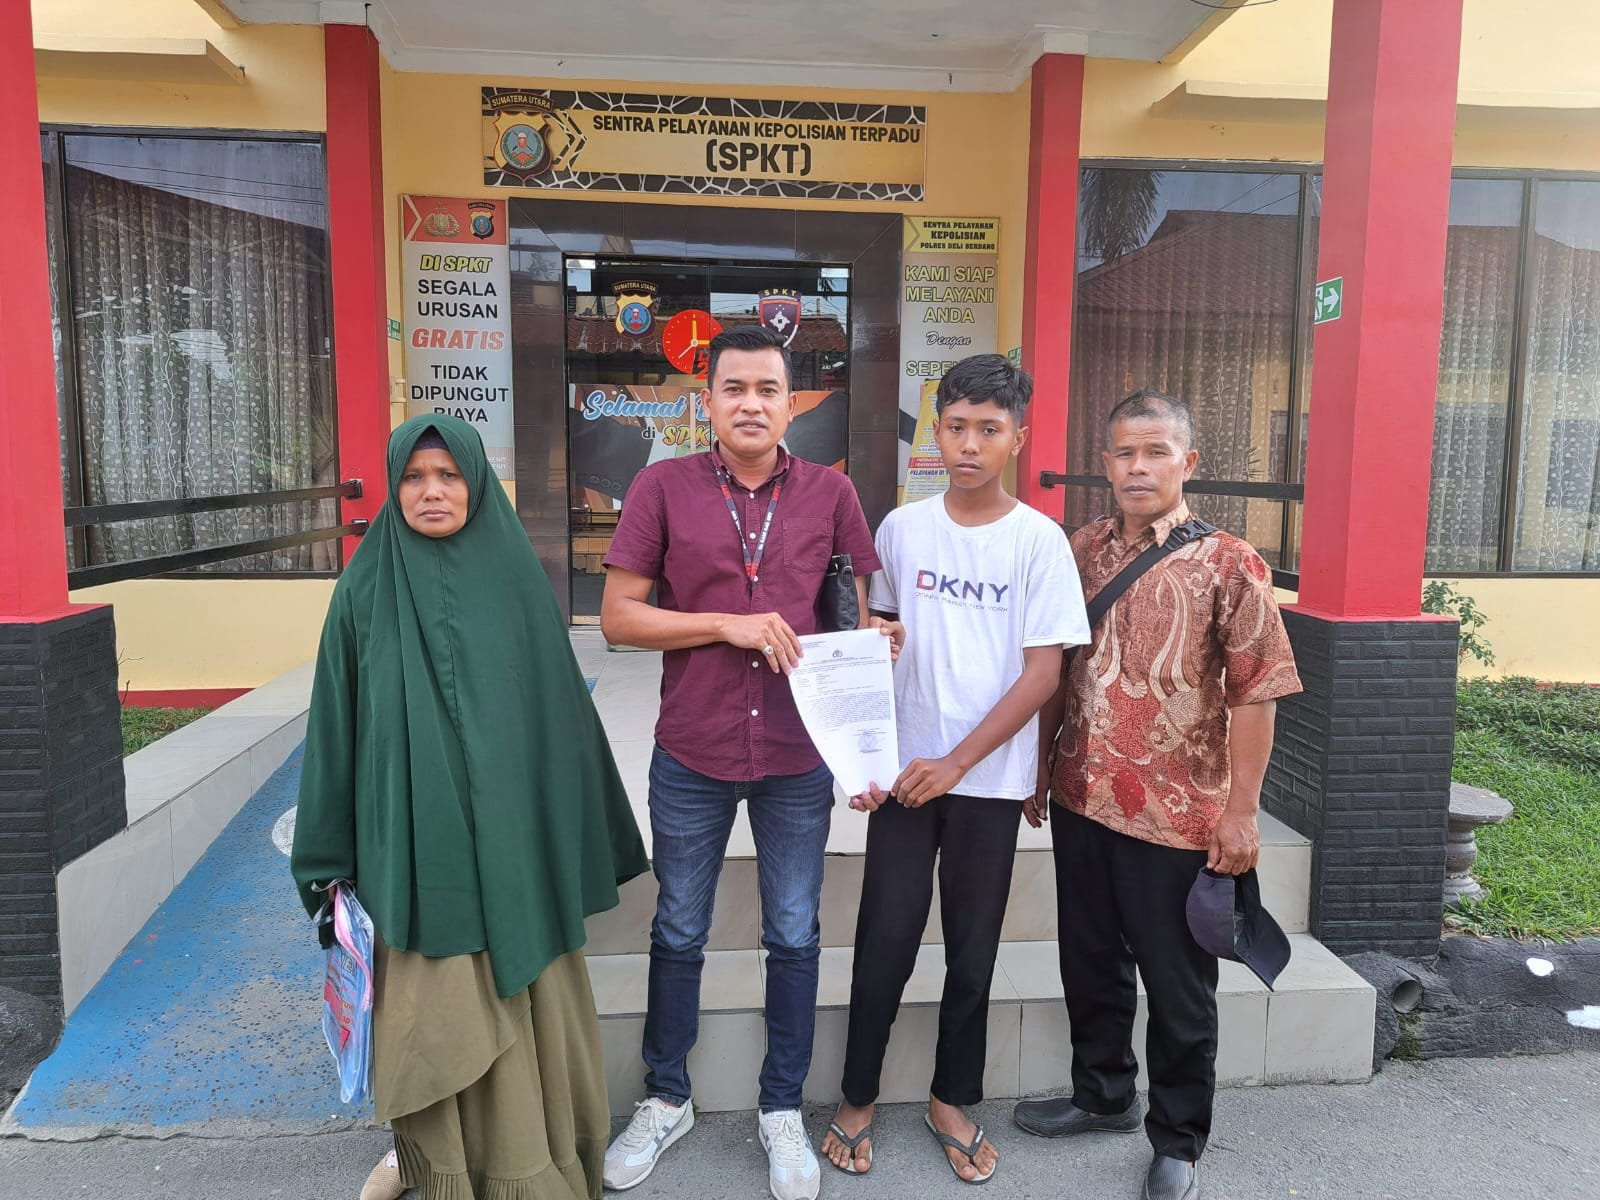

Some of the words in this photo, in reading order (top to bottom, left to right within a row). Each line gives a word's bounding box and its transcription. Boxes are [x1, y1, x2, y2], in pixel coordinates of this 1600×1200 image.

[492, 95, 528, 107] SUMATERA
[529, 96, 551, 109] UTARA
[593, 115, 655, 133] SENTRA
[658, 118, 751, 137] PELAYANAN
[754, 121, 846, 141] KEPOLISIAN
[850, 125, 921, 143] TERPADU
[705, 138, 812, 177] (SPKT)
[923, 221, 951, 229] SENTRA
[931, 231, 986, 240] KEPOLISIAN
[420, 255, 441, 271] DI
[443, 256, 493, 274] SPKT
[905, 265, 950, 281] KAMI
[954, 266, 996, 283] SIAP
[417, 279, 497, 297] SEGALA
[614, 282, 640, 291] SUMATERA
[640, 283, 656, 292] UTARA
[764, 288, 797, 296] SPKT
[906, 286, 995, 304] MELAYANI
[417, 301, 498, 319] URUSAN
[923, 307, 976, 324] ANDA
[411, 327, 505, 351] GRATIS
[926, 331, 972, 350] Dengan
[430, 364, 489, 381] TIDAK
[695, 361, 709, 380] 2
[906, 360, 957, 377] SEPE
[411, 385, 509, 402] DIPUNGUT
[583, 389, 688, 421] Selamat
[641, 425, 656, 440] di
[916, 569, 1009, 603] DKNY
